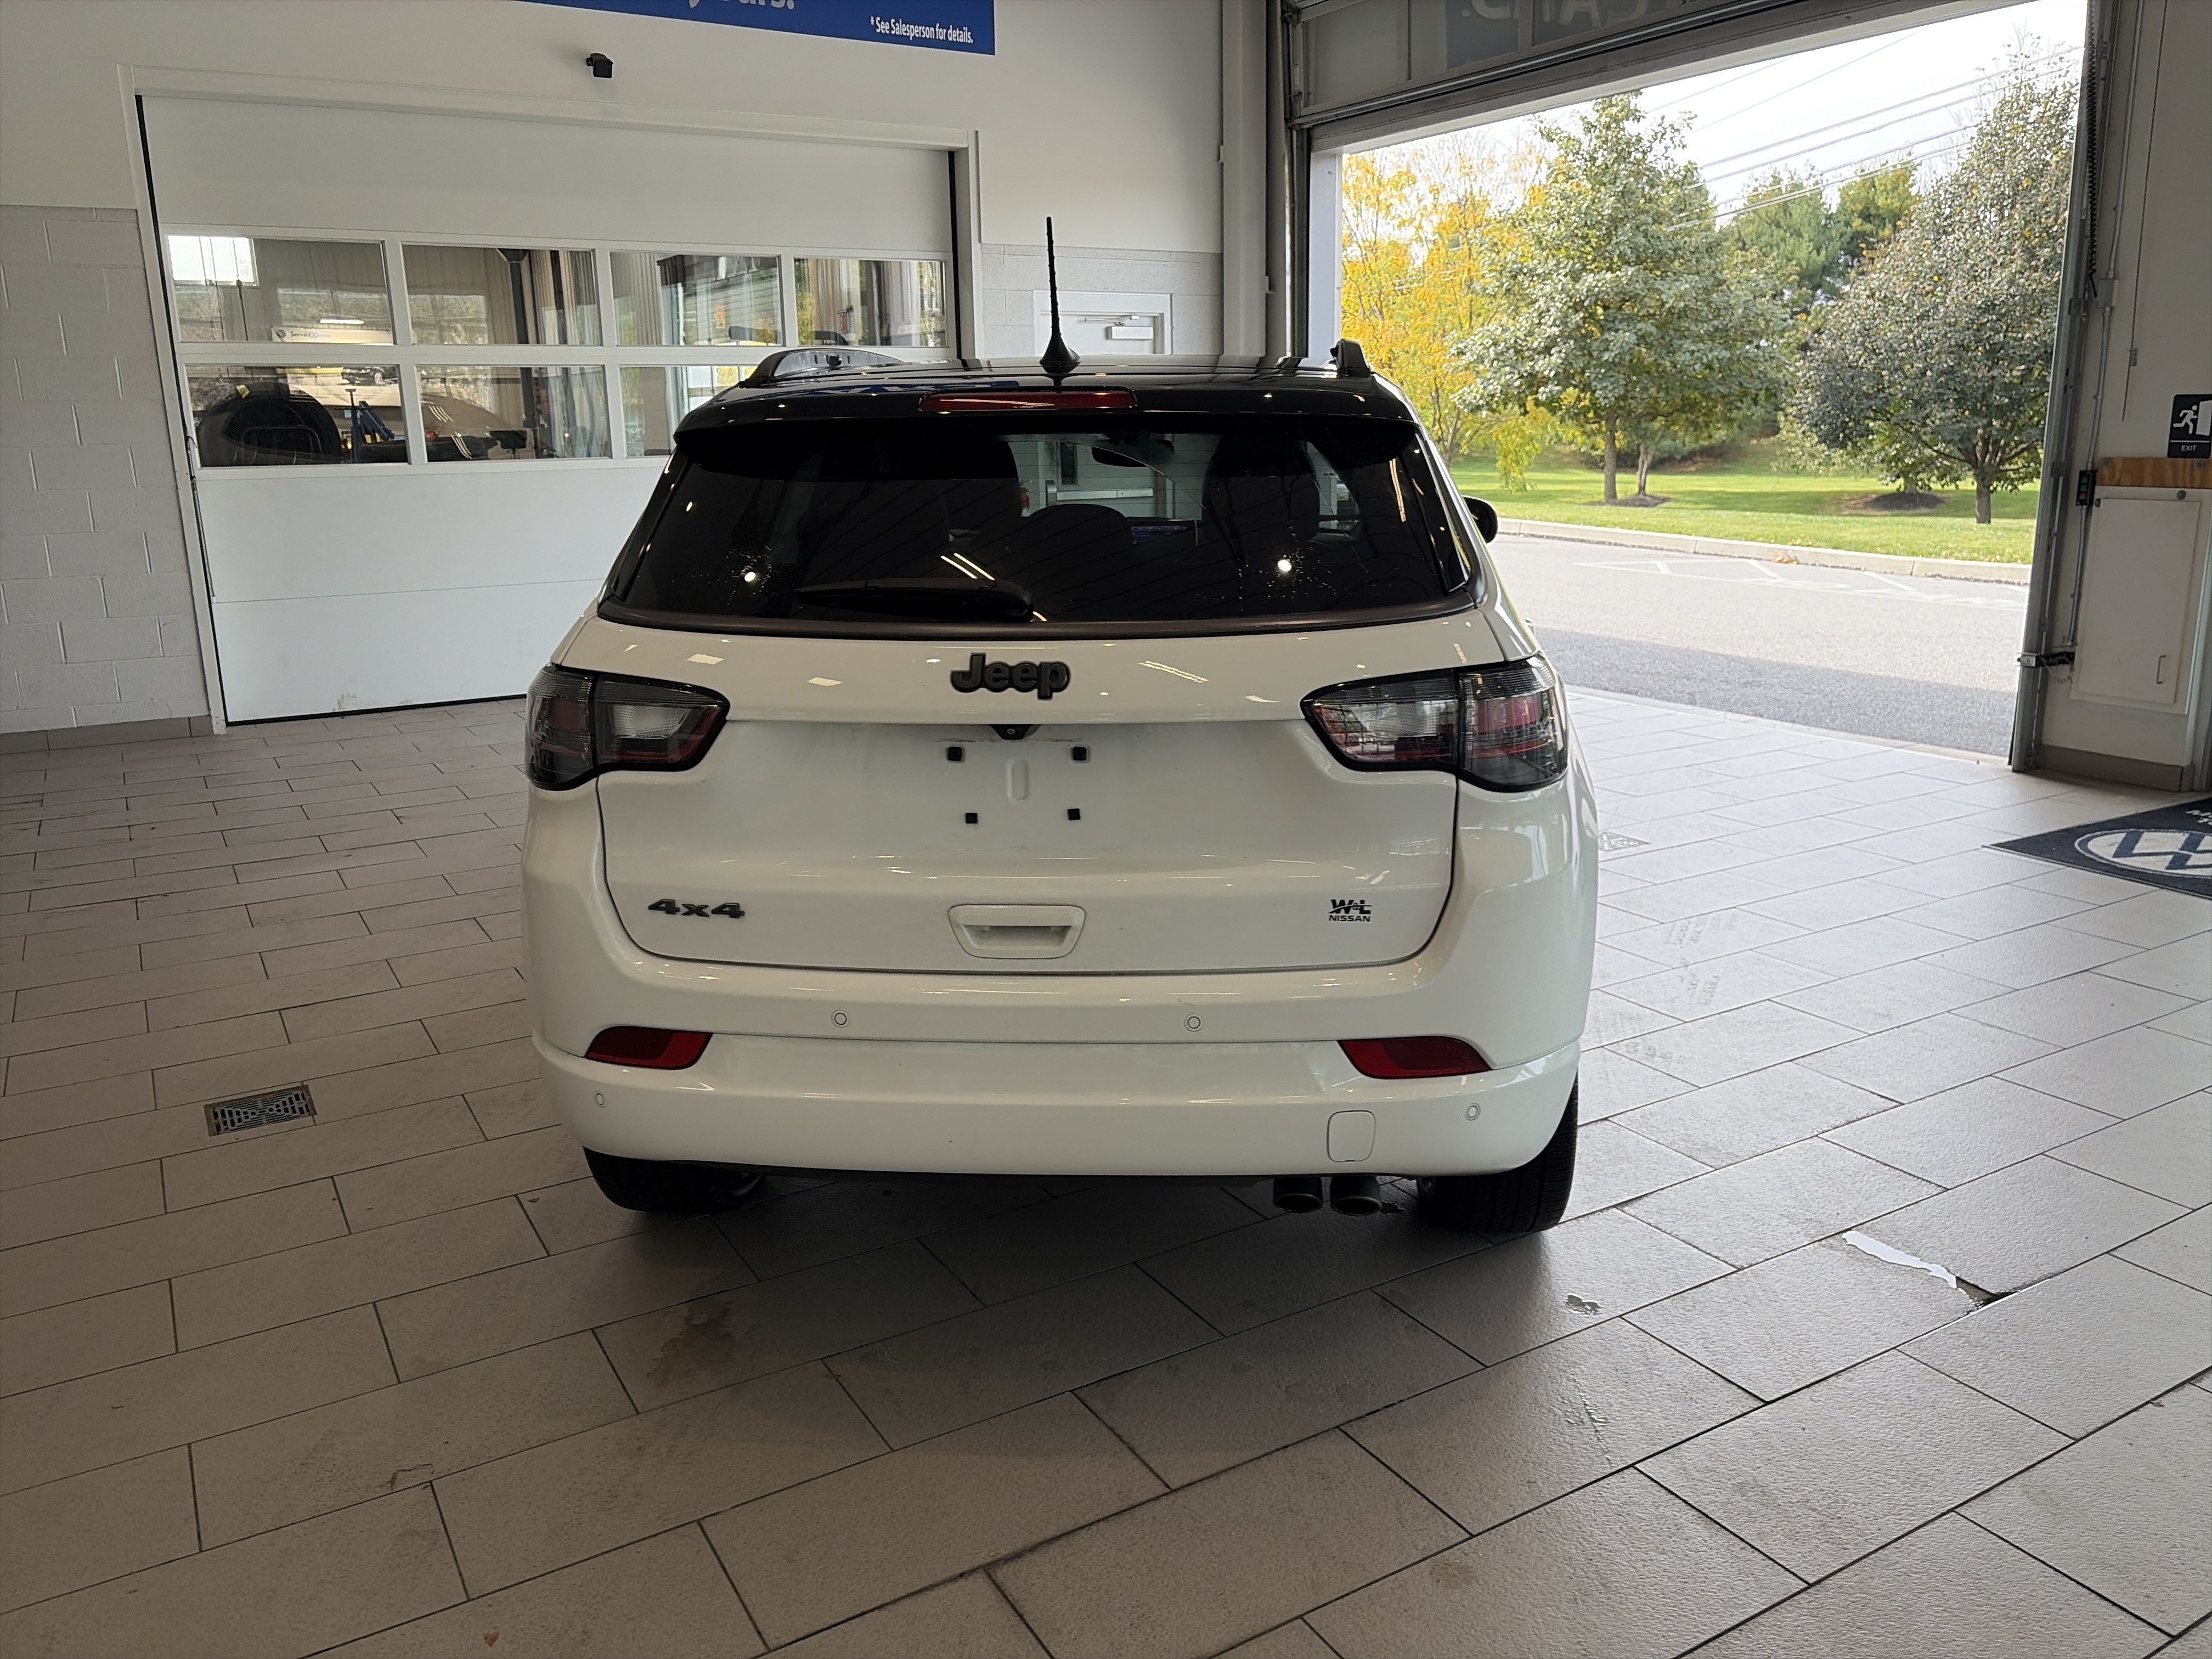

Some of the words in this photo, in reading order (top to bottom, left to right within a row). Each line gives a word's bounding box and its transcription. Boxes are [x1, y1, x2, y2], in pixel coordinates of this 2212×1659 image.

[891, 18, 935, 41] Salesperson
[936, 23, 946, 40] for
[947, 25, 974, 44] details.
[950, 652, 1071, 700] Jeep
[648, 899, 745, 918] 4x4
